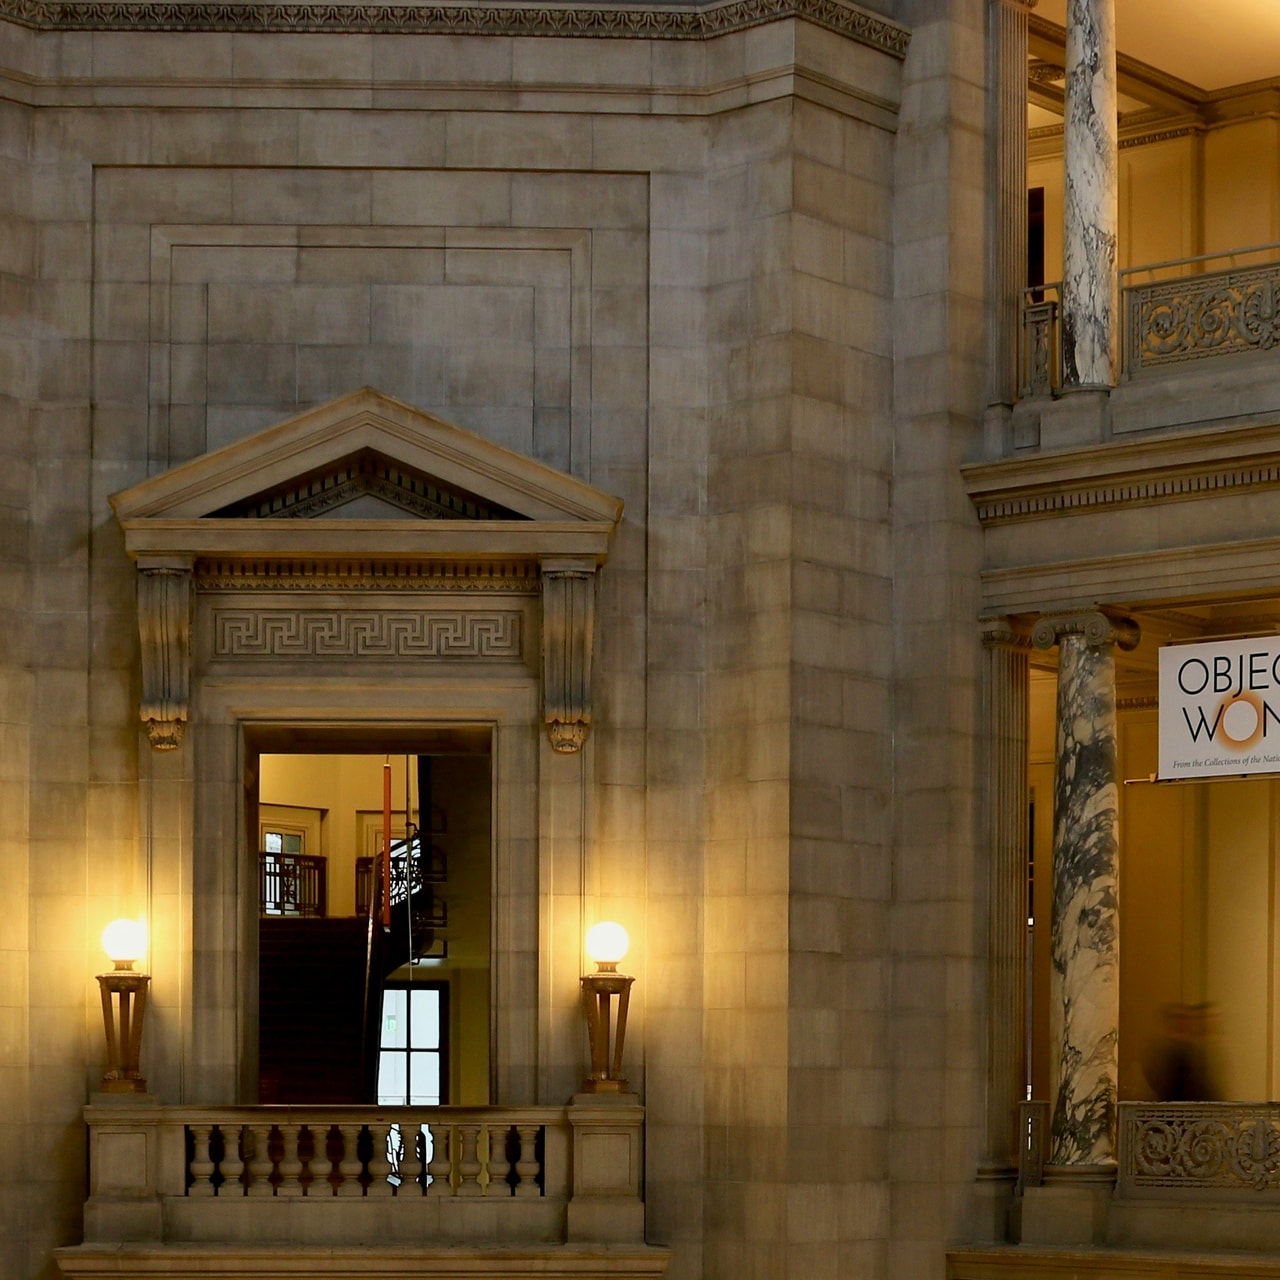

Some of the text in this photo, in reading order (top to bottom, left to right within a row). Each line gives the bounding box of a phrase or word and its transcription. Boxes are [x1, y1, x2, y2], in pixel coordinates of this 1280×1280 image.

[1172, 760, 1192, 769] From
[1192, 759, 1204, 767] the
[1204, 756, 1241, 767] Collections
[1241, 756, 1250, 765] of
[1250, 755, 1262, 764] the
